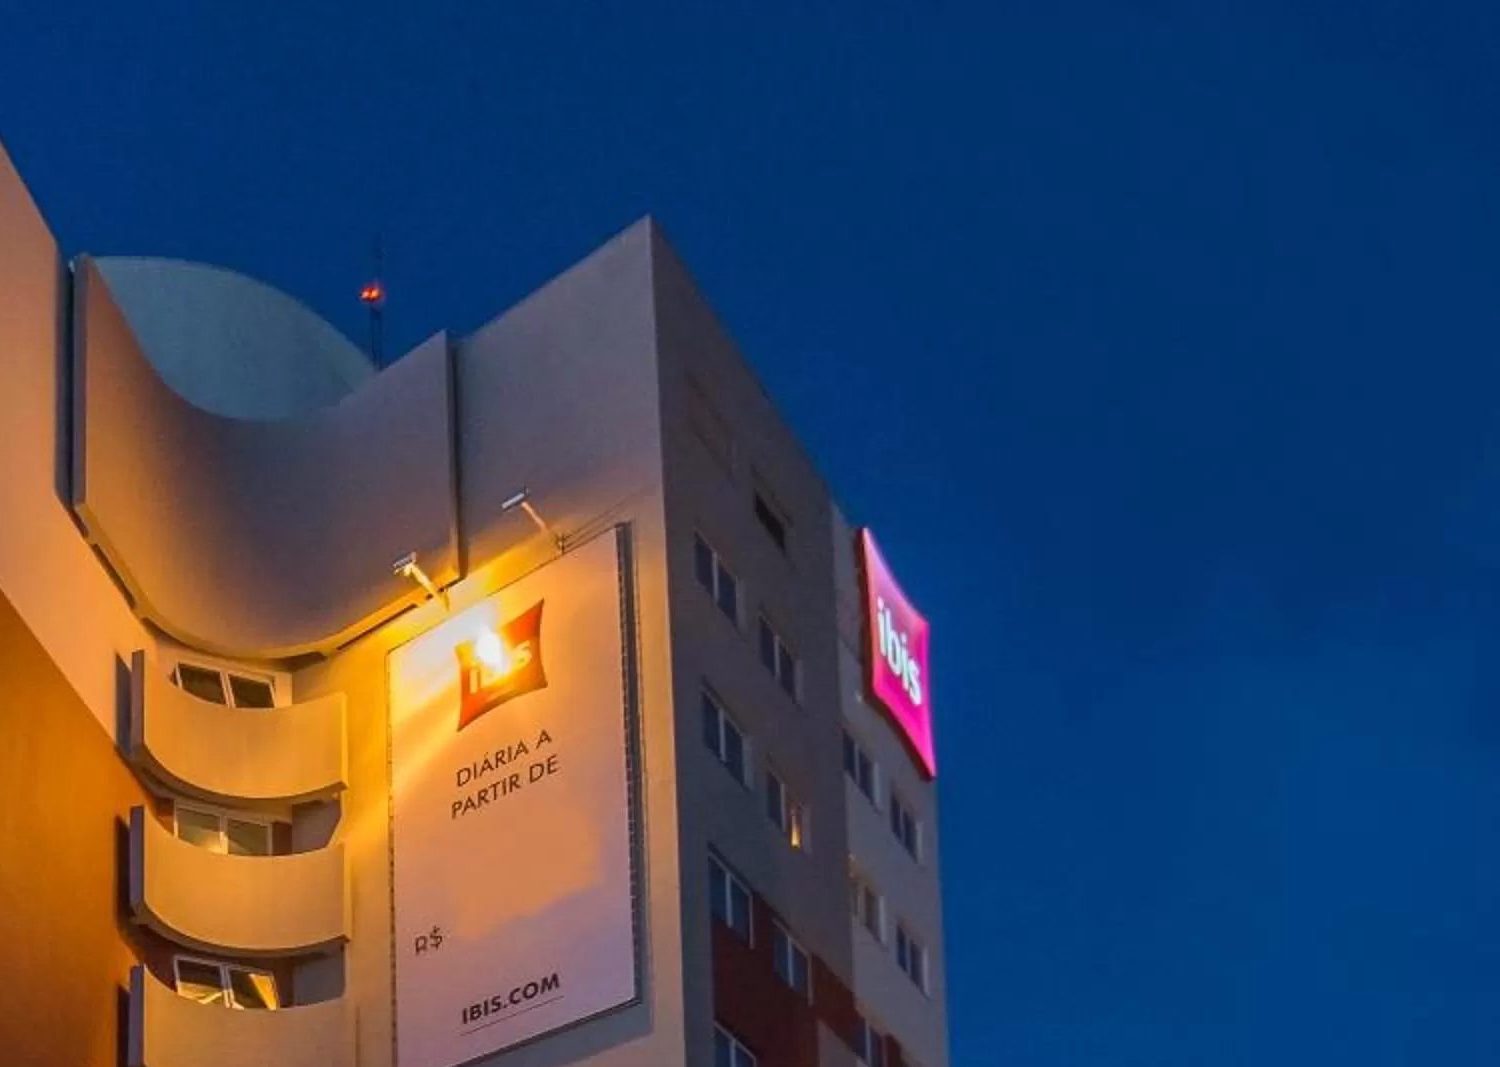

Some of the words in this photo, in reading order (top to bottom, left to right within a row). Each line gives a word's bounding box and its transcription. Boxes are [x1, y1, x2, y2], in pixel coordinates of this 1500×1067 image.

[878, 596, 921, 704] ibis
[451, 773, 521, 819] PARTIR
[529, 754, 558, 784] DE
[456, 740, 529, 787] DIÁRIA
[536, 729, 553, 749] A
[462, 973, 560, 1025] IBIS.COM
